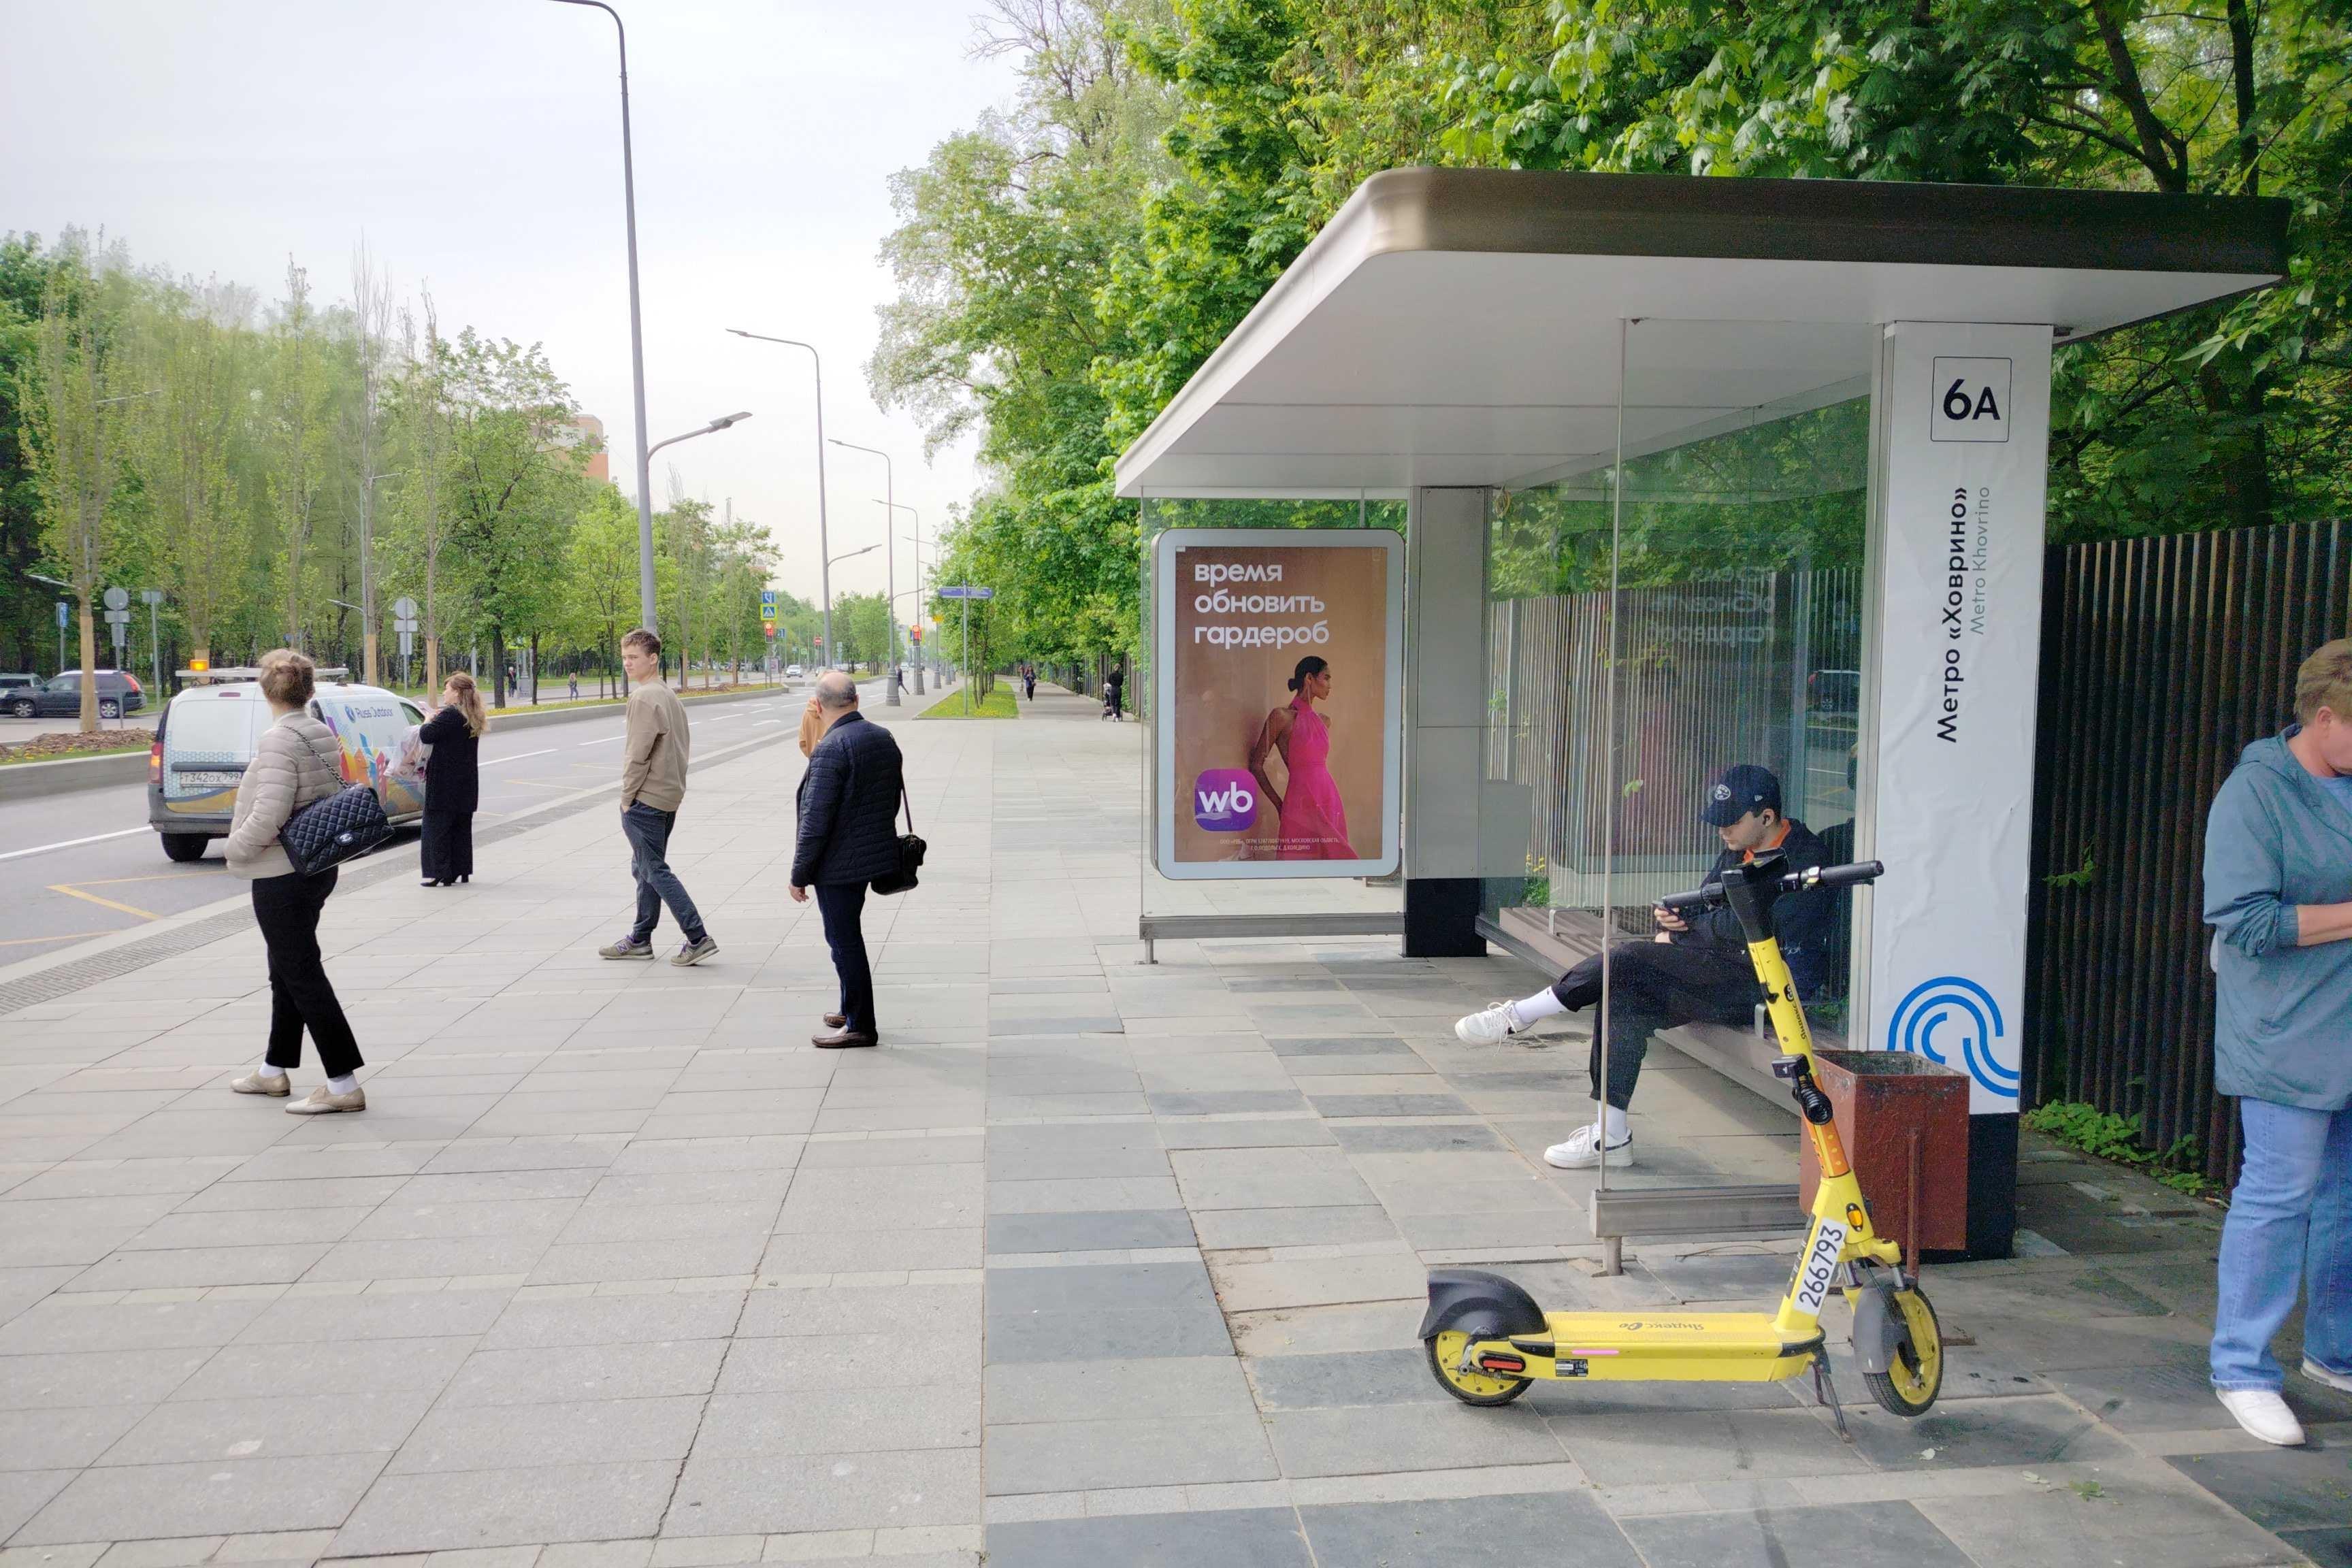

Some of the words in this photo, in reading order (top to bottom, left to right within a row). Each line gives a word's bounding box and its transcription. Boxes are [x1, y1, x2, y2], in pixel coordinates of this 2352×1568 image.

[1943, 379, 2001, 420] 6А
[1972, 487, 1990, 571] Khovrino
[1194, 563, 1283, 587] время
[1942, 487, 1968, 640] «Ховрино»
[1194, 588, 1325, 613] обновить
[1970, 577, 1987, 635] Metro
[1194, 620, 1330, 649] гардероб
[356, 707, 372, 719] Russ
[1937, 648, 1964, 743] Метро
[1198, 781, 1254, 813] wb
[1799, 1225, 1842, 1307] 266793
